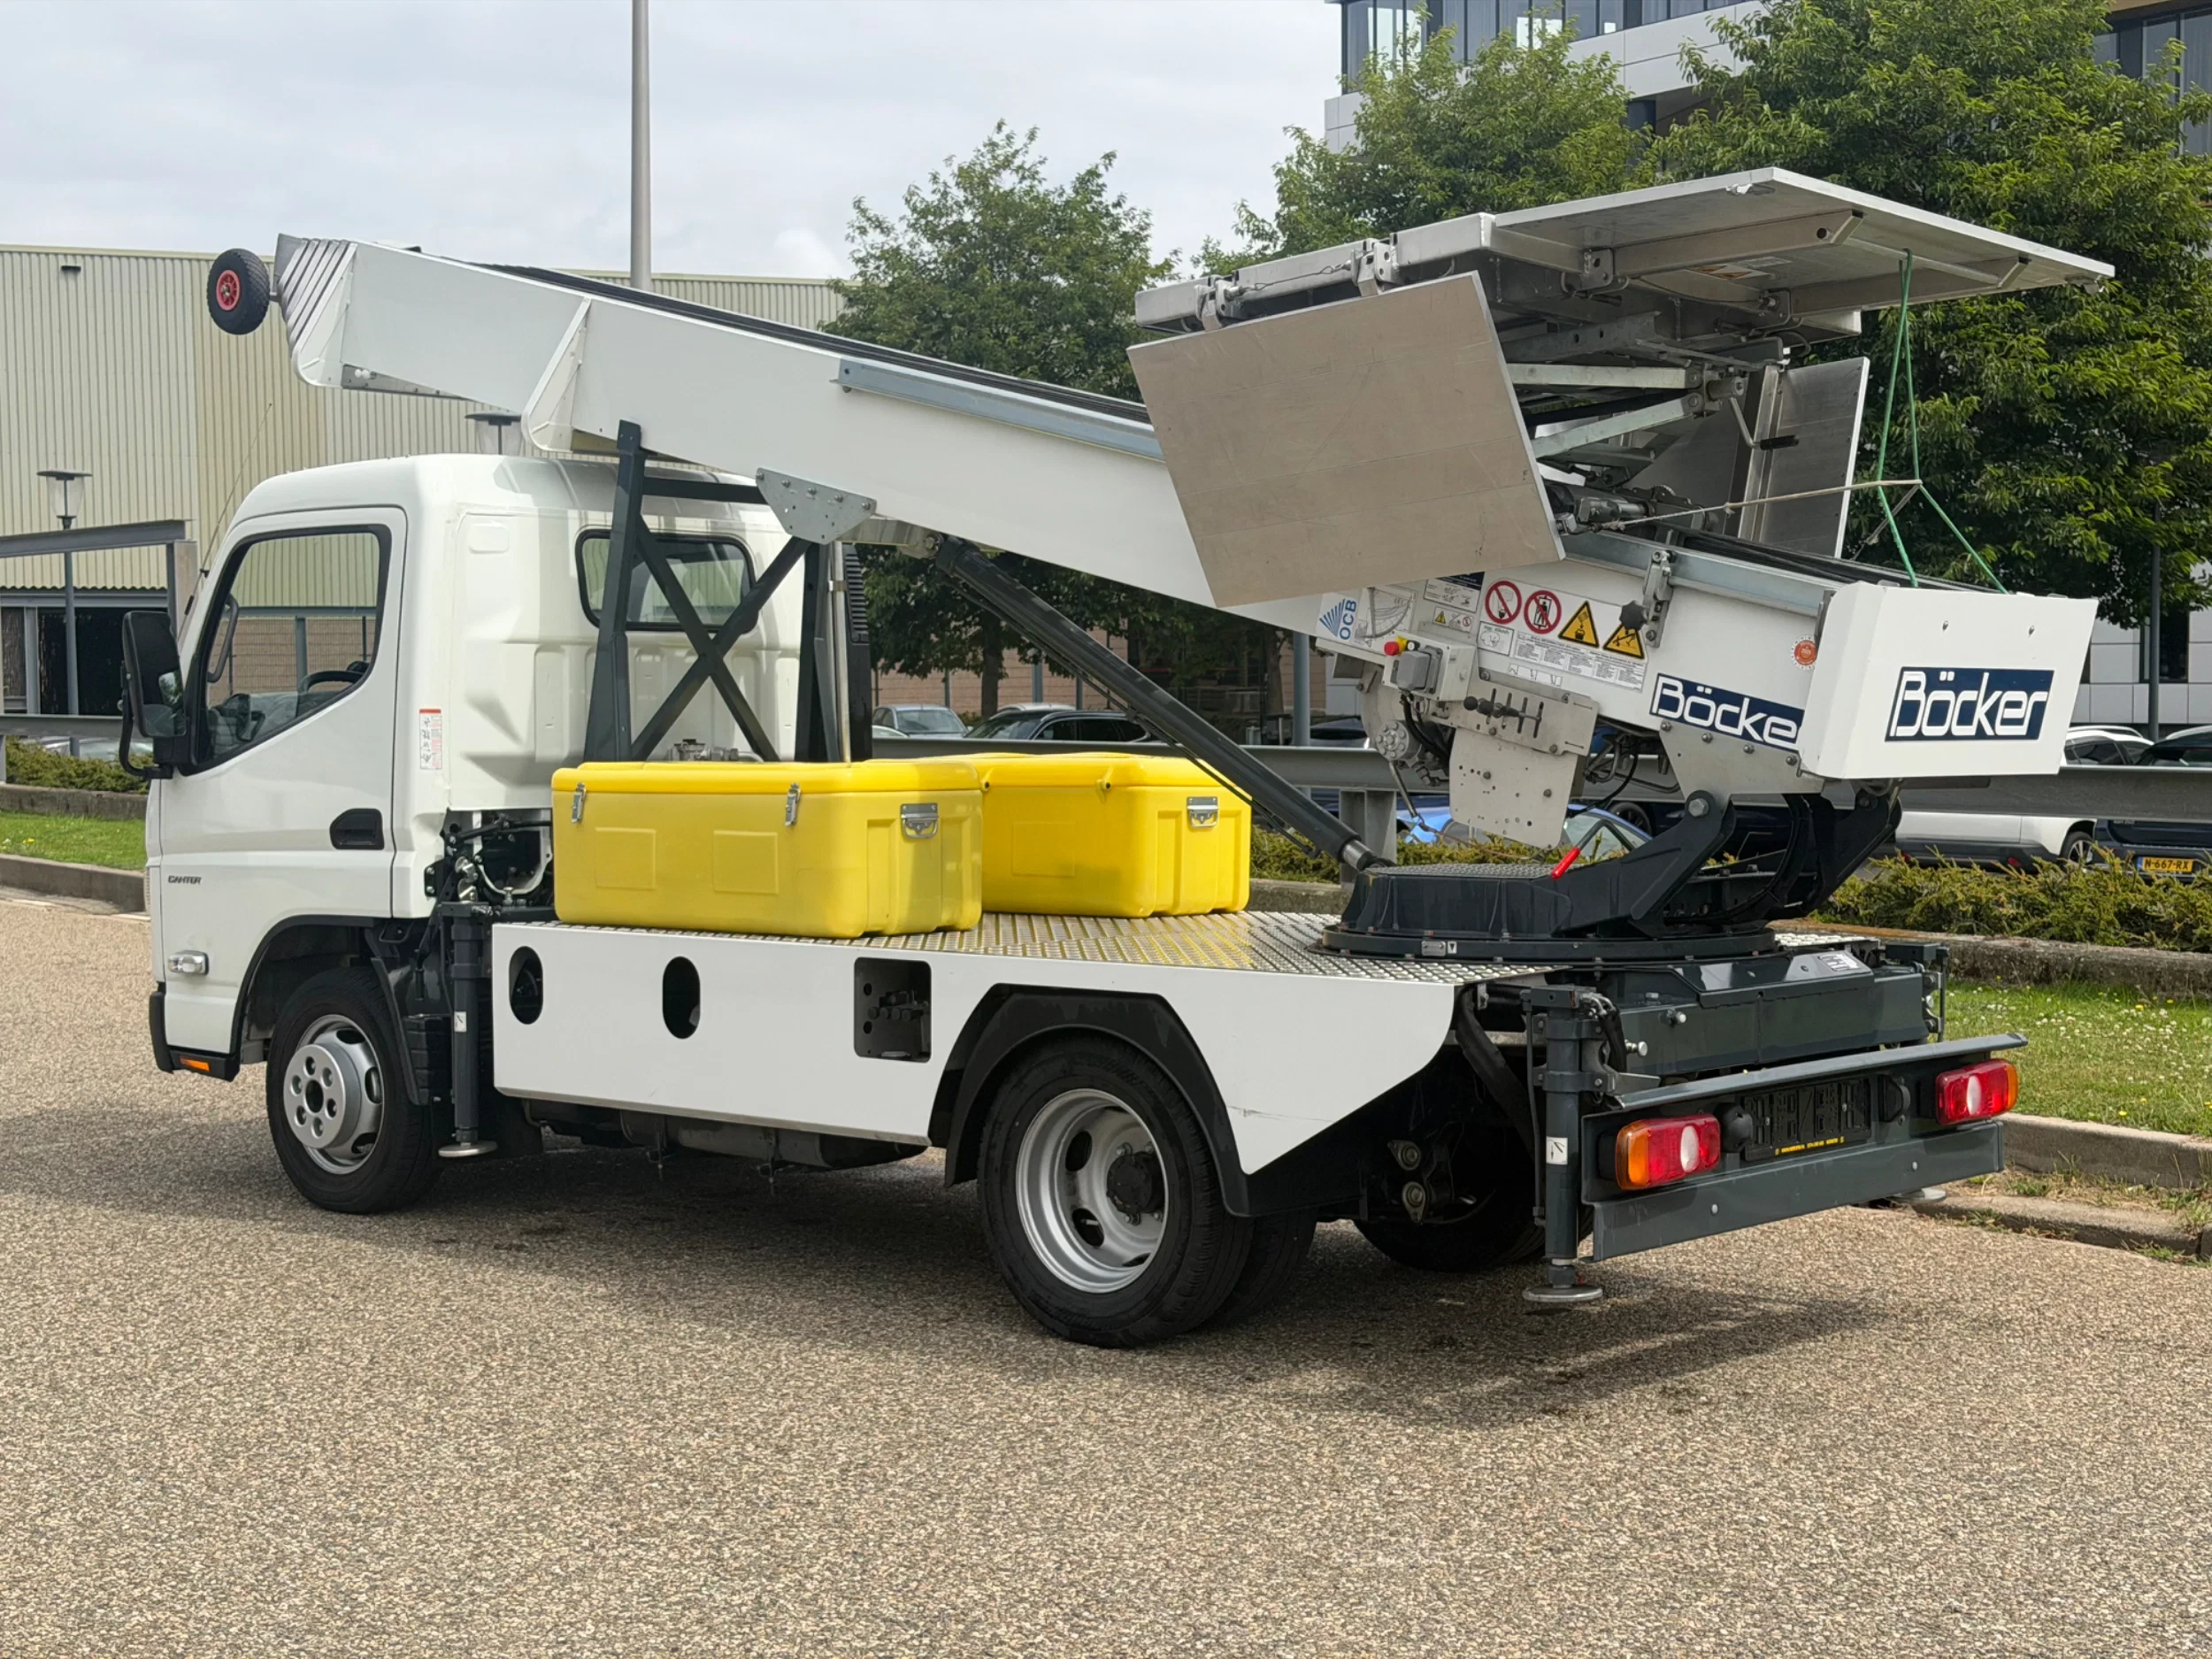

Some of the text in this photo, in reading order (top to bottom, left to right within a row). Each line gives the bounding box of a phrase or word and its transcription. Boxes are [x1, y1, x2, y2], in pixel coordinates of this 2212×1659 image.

[1340, 600, 1357, 640] OCB
[1652, 676, 1799, 750] Böcke
[1889, 671, 2048, 736] Böcker
[168, 875, 202, 885] CANTER
[2144, 858, 2189, 870] N-667-RX
